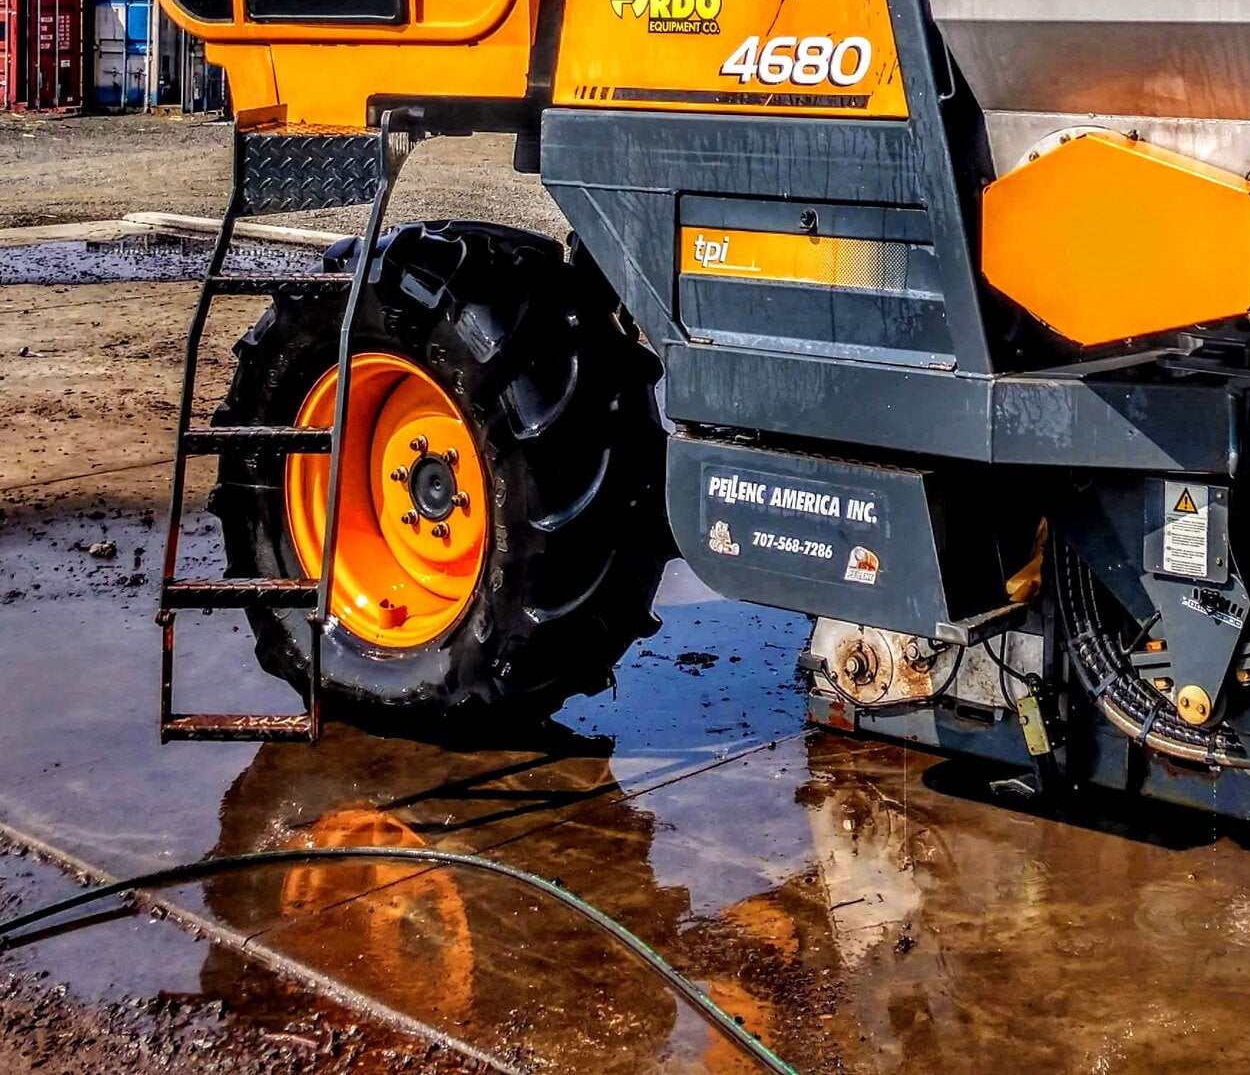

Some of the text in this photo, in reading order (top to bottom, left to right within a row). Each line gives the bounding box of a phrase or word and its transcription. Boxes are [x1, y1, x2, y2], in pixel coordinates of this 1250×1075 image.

[649, 21, 720, 34] EQUIPMENT CO.
[720, 35, 872, 87] 4680
[694, 234, 730, 268] tpi
[708, 475, 878, 524] PELLENC AMERICA INC.
[752, 531, 833, 559] 707-568-7286
